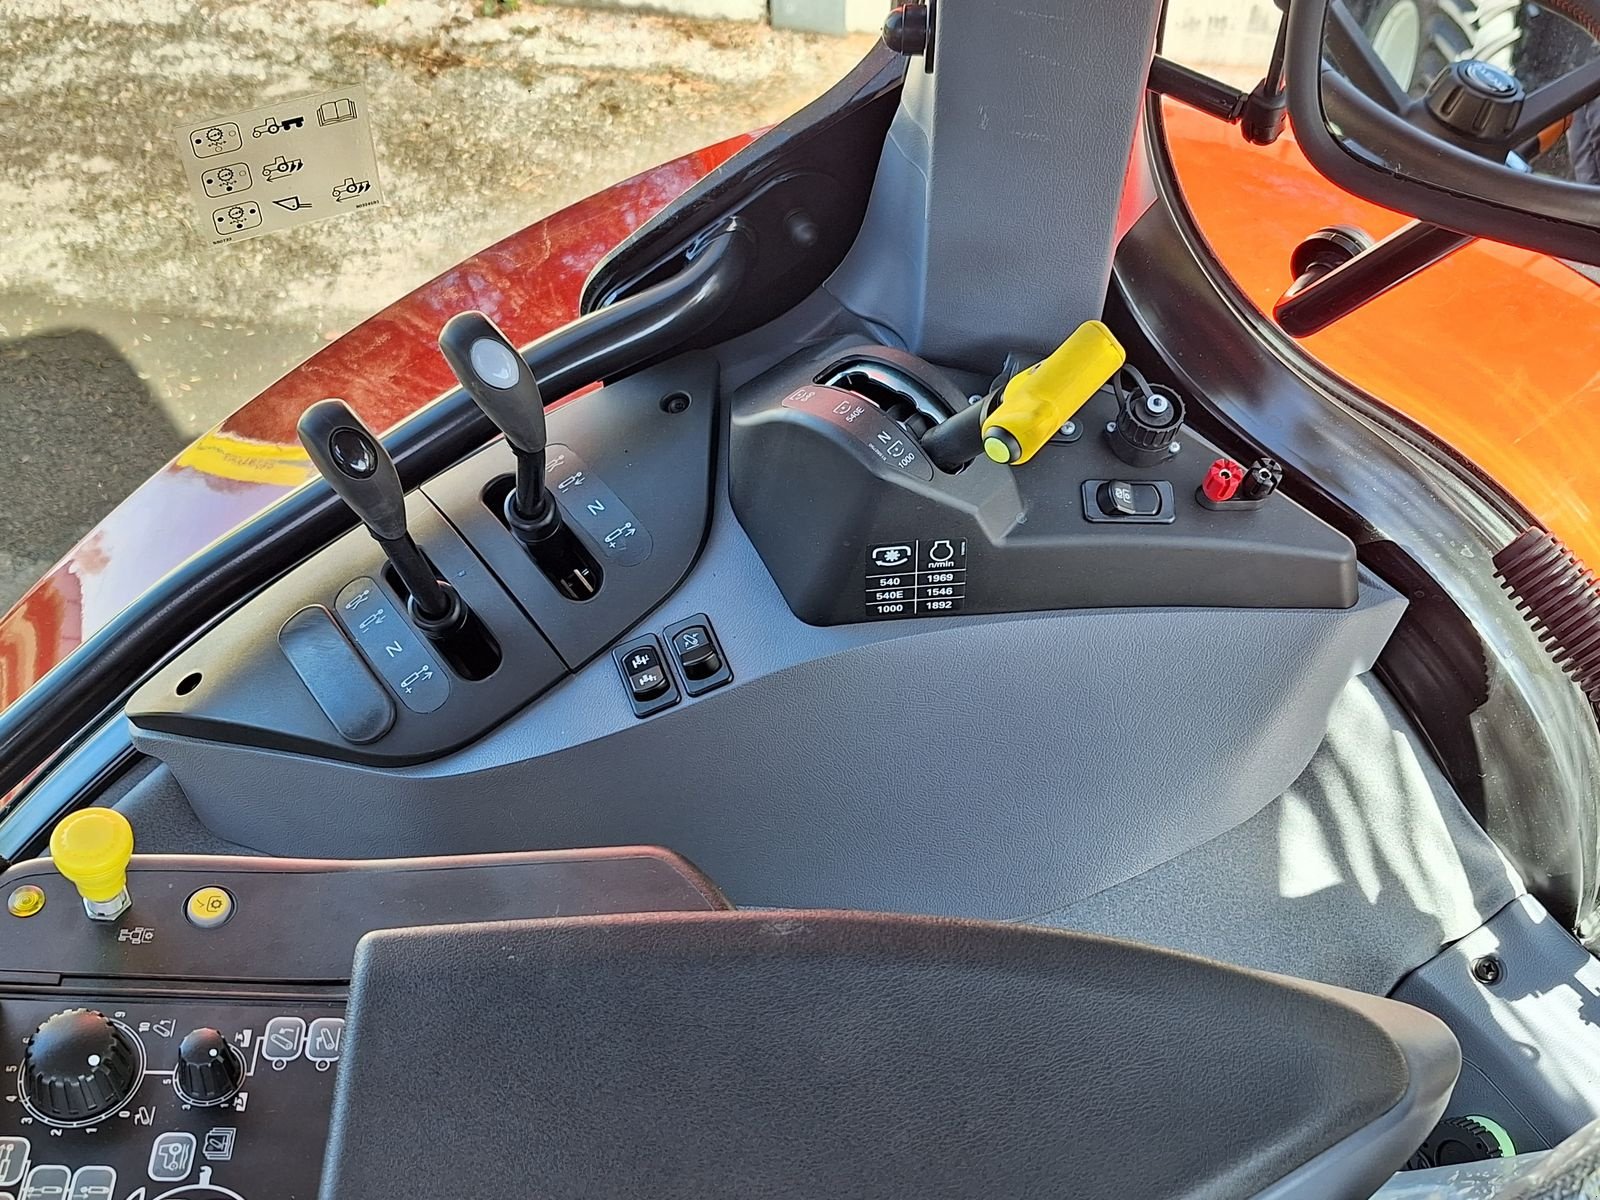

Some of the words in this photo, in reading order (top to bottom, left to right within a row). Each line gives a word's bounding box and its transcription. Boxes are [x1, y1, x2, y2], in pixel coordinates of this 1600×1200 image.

[846, 406, 865, 423] 540E
[877, 430, 892, 444] N
[898, 452, 915, 469] 1000
[587, 499, 605, 516] N
[928, 560, 954, 568] n/min
[879, 577, 900, 586] 540
[927, 573, 954, 583] 1969
[876, 590, 904, 600] 540E
[926, 587, 953, 596] 1546
[877, 604, 903, 613] 1000
[926, 600, 952, 609] 1892
[386, 640, 403, 657] N
[139, 1022, 151, 1032] 10
[119, 1110, 131, 1118] 0
[21, 1117, 33, 1125] 3
[51, 1129, 62, 1137] 2
